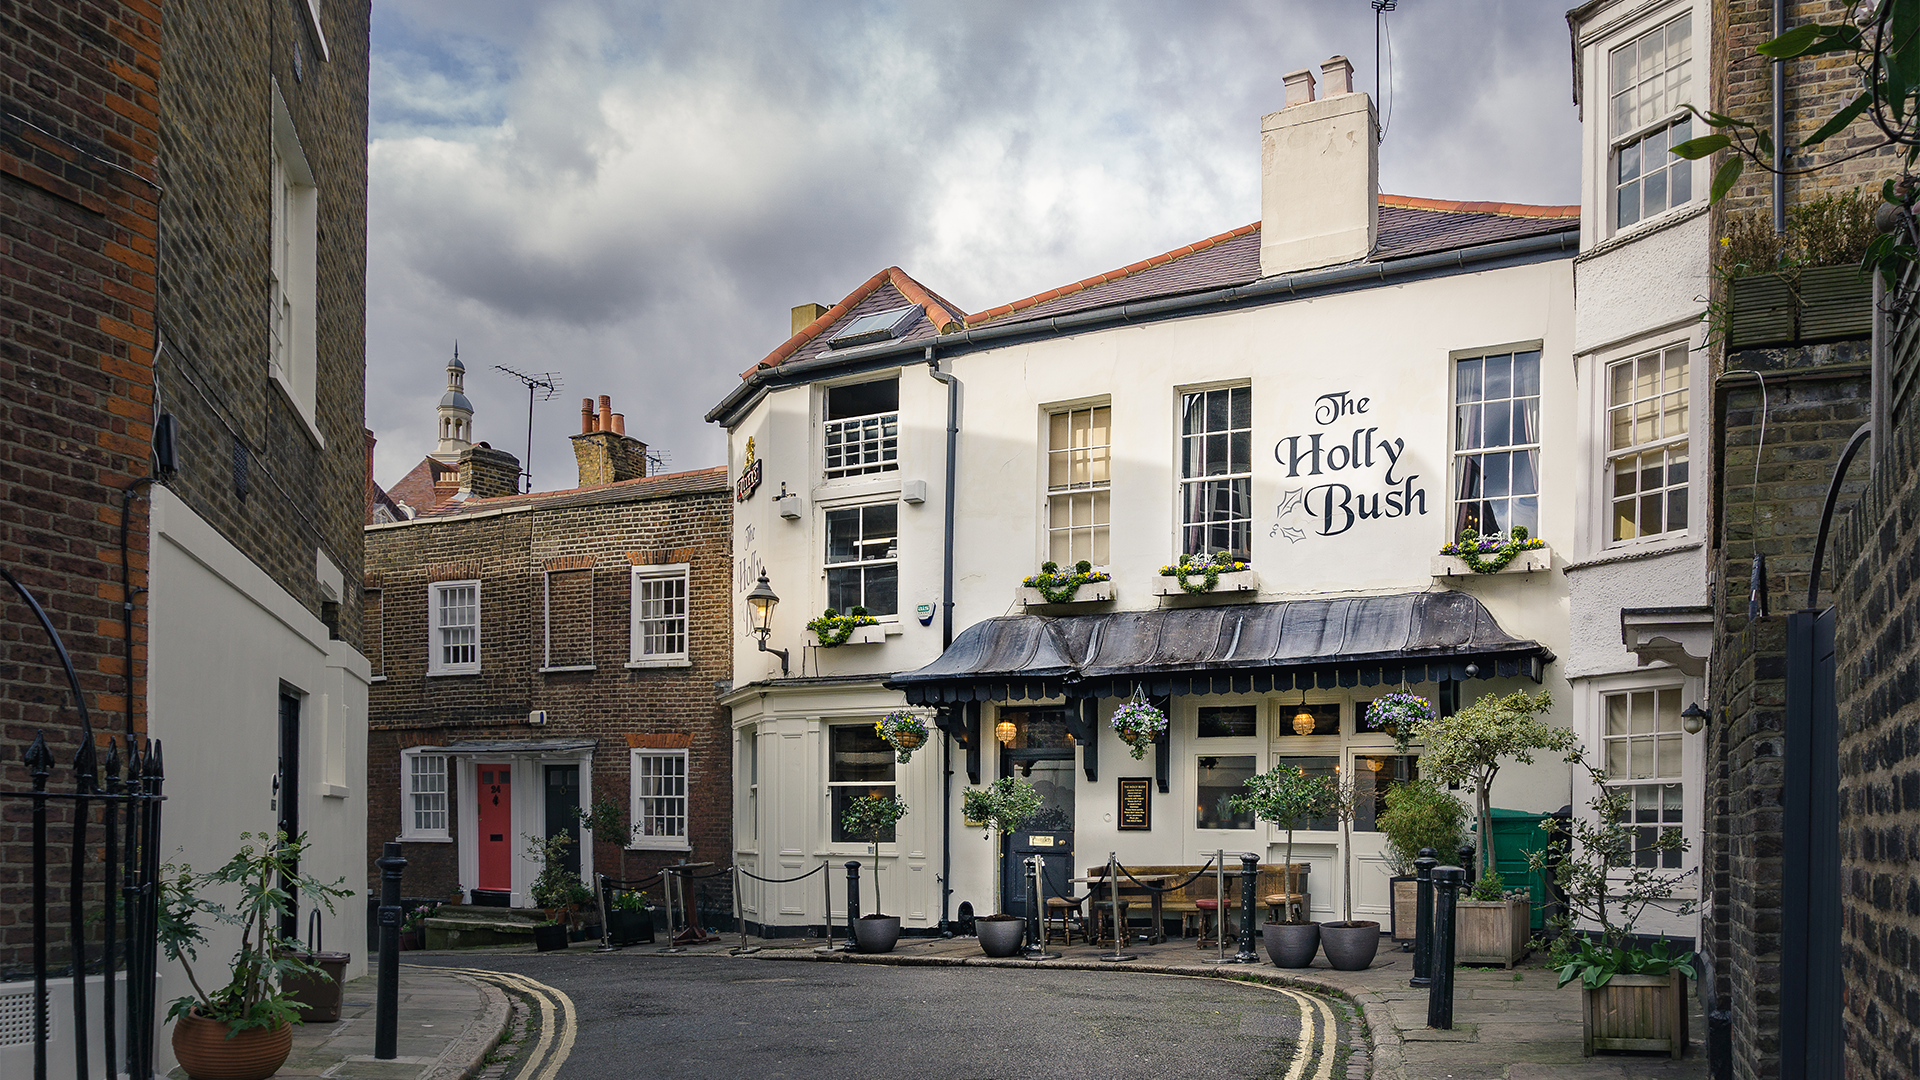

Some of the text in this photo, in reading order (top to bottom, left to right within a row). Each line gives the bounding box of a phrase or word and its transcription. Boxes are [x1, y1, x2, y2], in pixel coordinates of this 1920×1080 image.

[1315, 390, 1371, 426] The
[1274, 427, 1405, 486] Holly
[1303, 475, 1429, 537] Bush
[490, 785, 501, 794] 24
